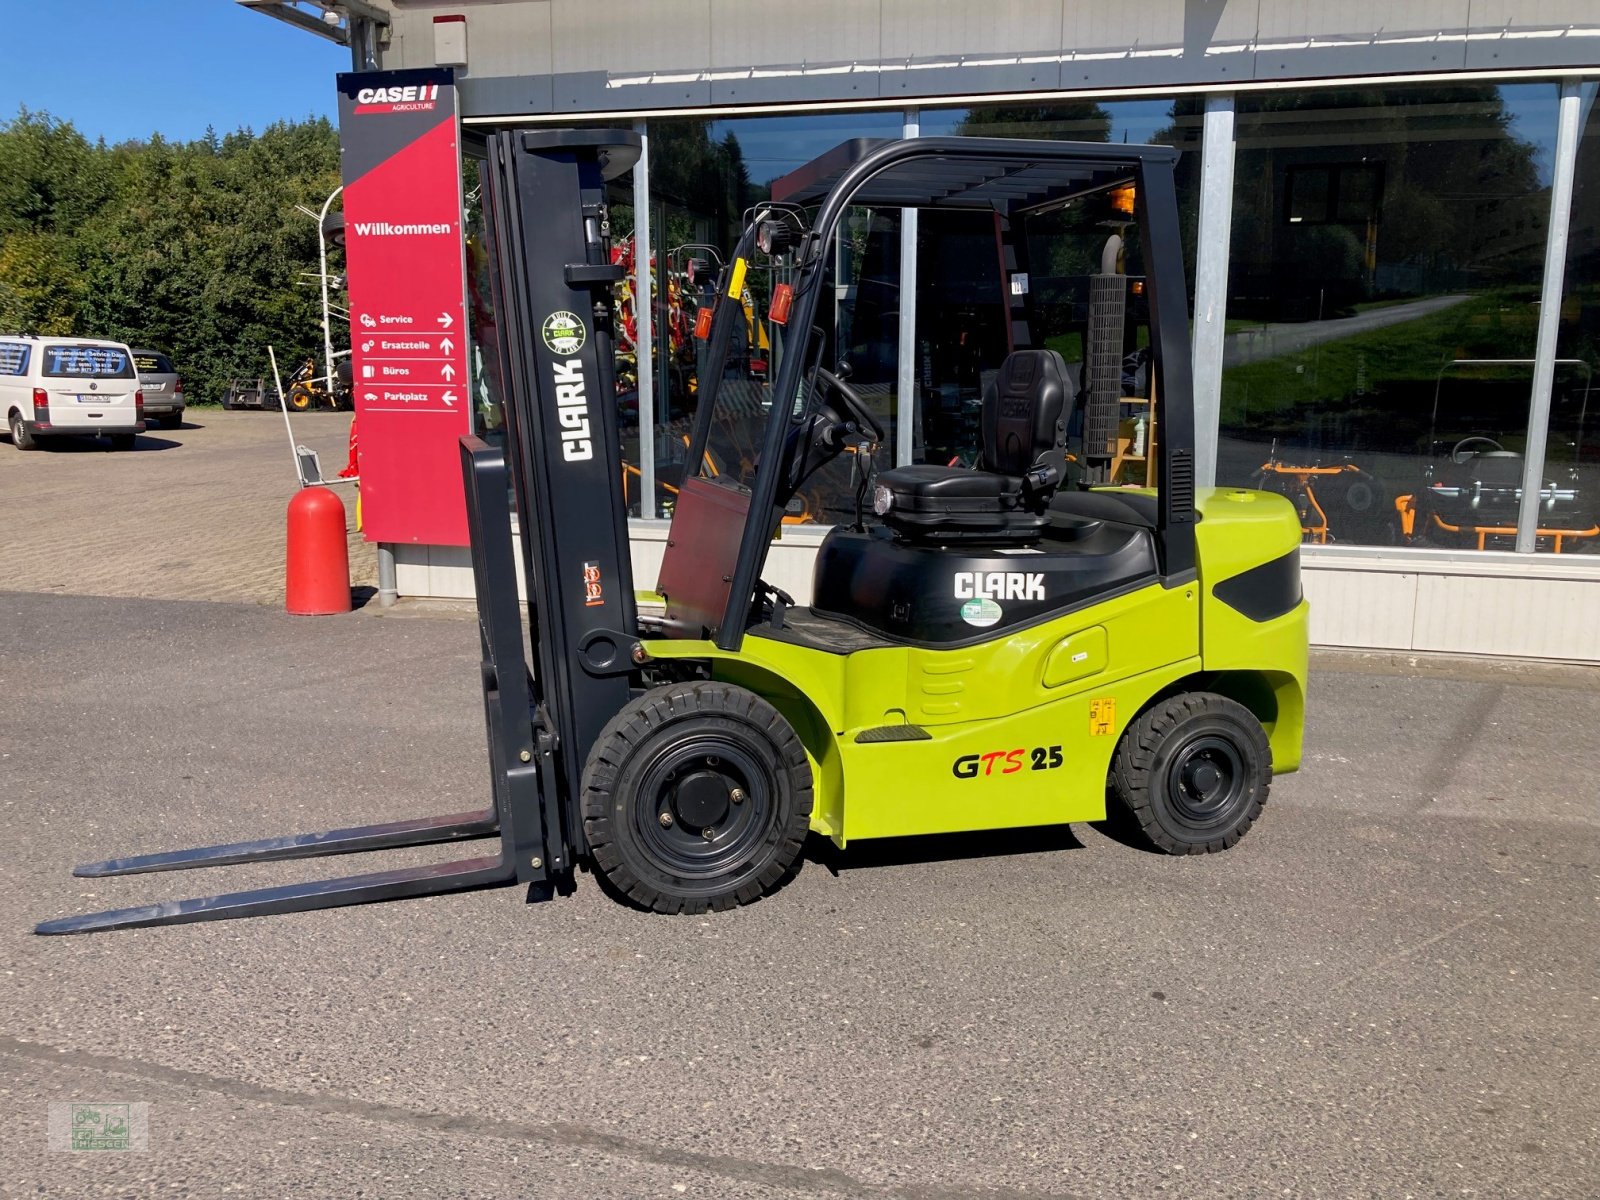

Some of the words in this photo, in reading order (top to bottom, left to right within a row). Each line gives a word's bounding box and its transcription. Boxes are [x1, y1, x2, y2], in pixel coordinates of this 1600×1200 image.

[357, 85, 417, 104] CASE
[392, 102, 433, 111] AGRICULTURE
[354, 223, 450, 236] Willkommen
[380, 315, 413, 324] Service
[553, 329, 575, 337] CLARK
[381, 341, 430, 350] Ersatzteile
[383, 366, 410, 376] Büros
[384, 392, 428, 402] Parkplatz
[552, 359, 593, 462] CLARK
[954, 572, 1046, 600] CLARK
[952, 749, 1025, 779] GTS
[1031, 746, 1064, 770] 25
